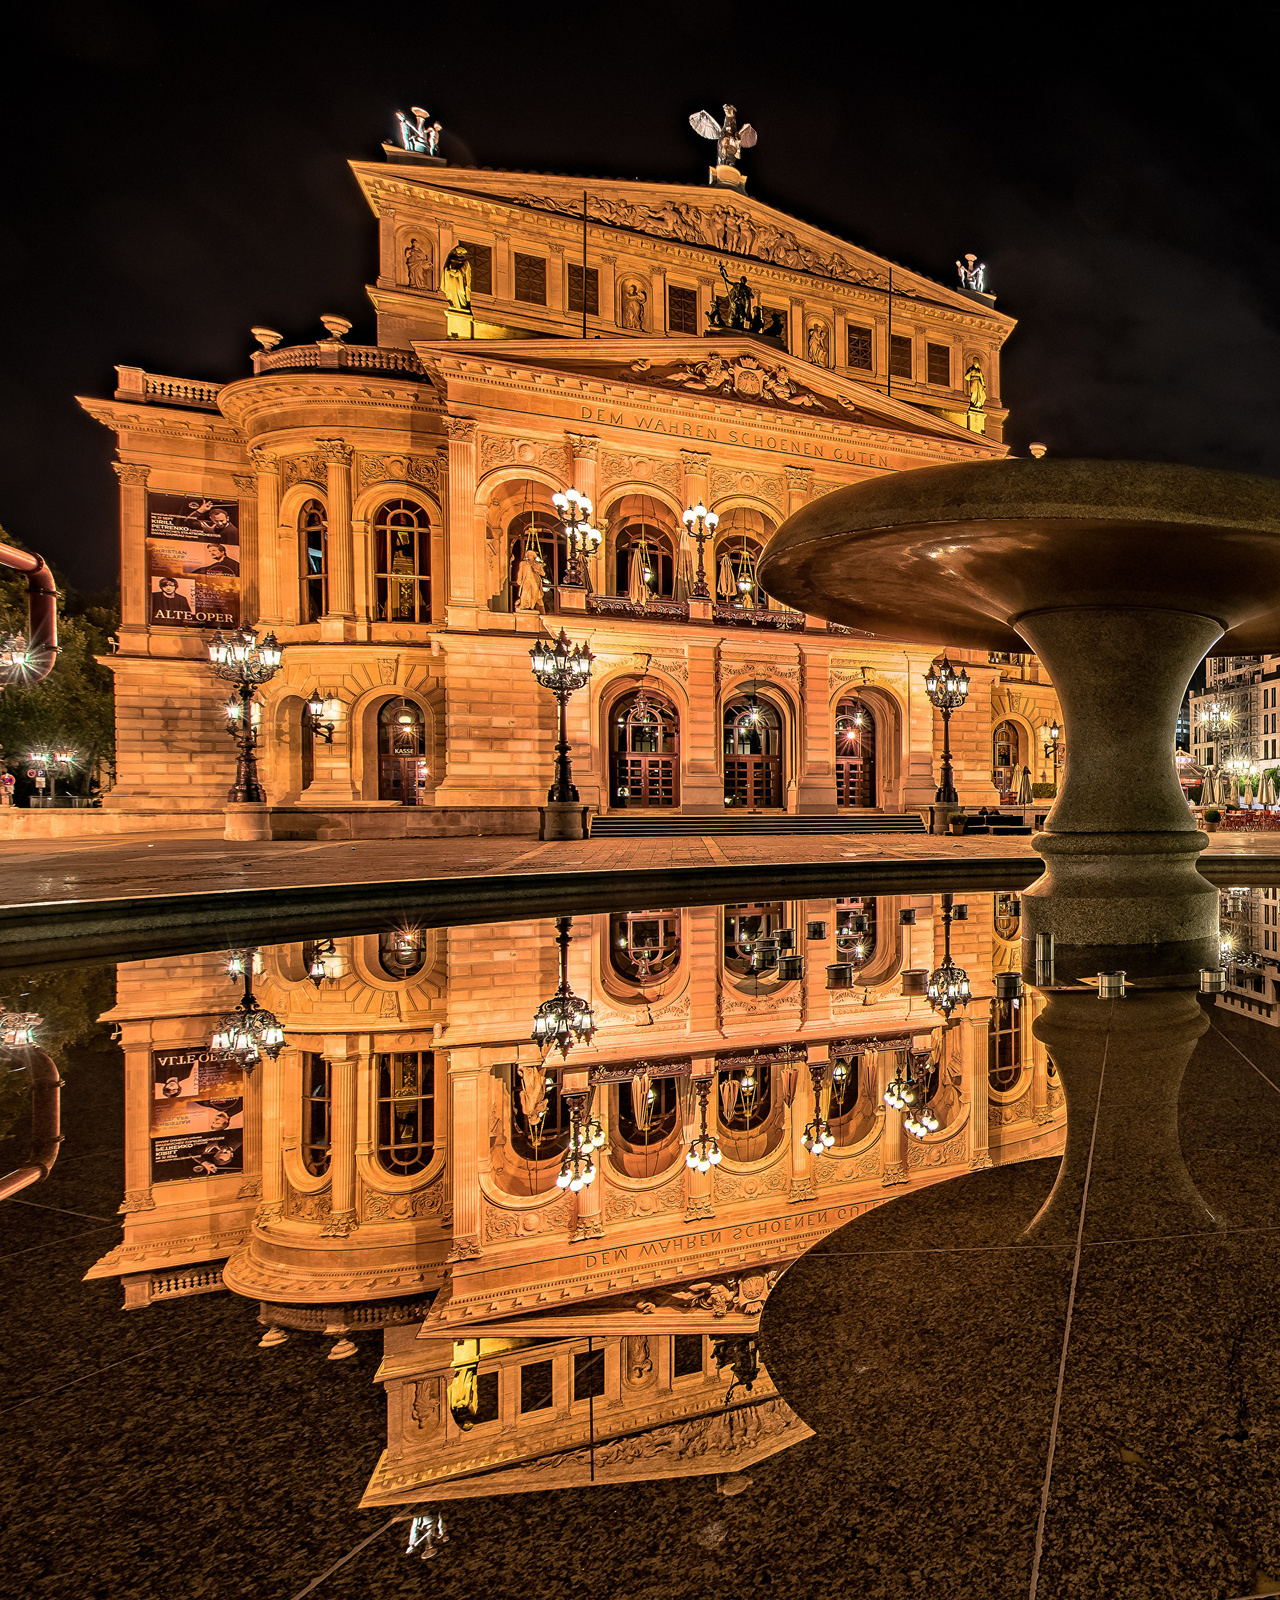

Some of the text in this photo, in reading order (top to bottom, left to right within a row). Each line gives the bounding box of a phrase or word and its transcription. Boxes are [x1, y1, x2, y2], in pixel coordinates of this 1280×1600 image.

[581, 405, 894, 469] DEM WAHREN SCHOENEN GUTEN.
[151, 523, 190, 532] PETRENKO
[154, 609, 234, 623] ALTE OPER
